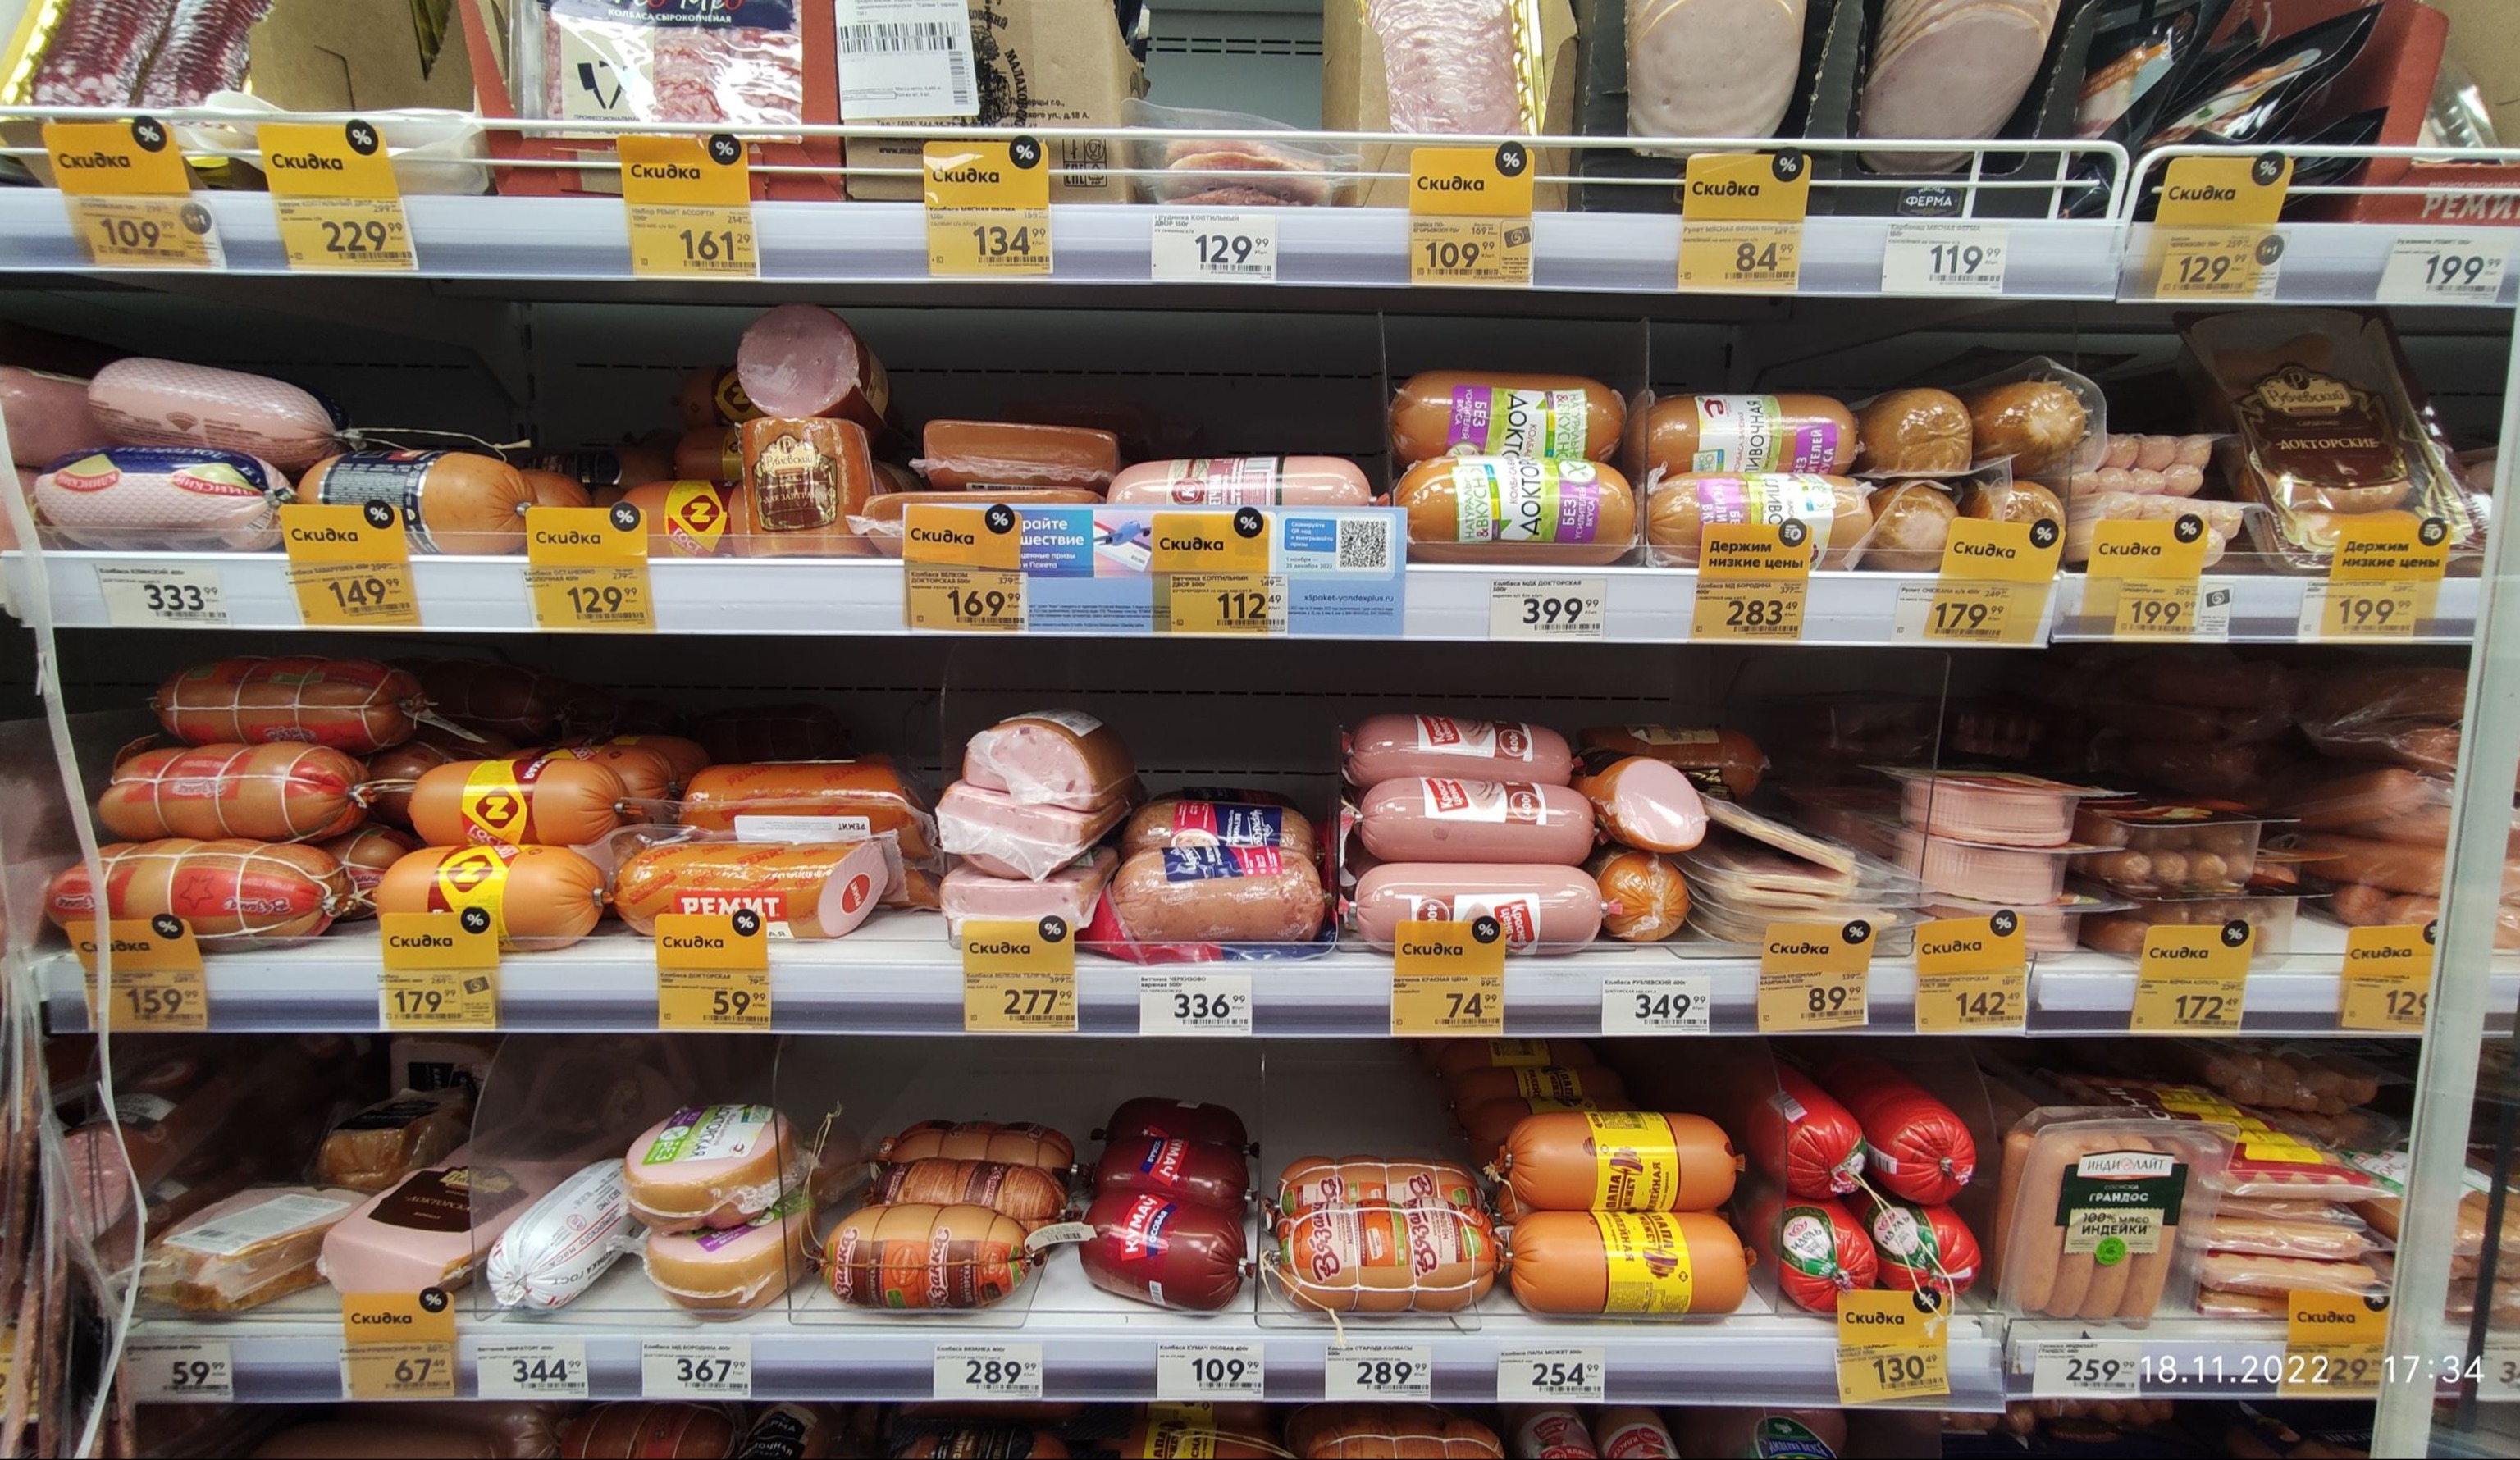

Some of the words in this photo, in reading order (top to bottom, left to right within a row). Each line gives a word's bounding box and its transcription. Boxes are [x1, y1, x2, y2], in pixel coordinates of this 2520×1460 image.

[609, 8, 655, 21] КОЛБАСА
[59, 153, 130, 168] Скидка
[272, 154, 343, 170] Скидка
[632, 164, 700, 179] Скидка
[933, 168, 999, 183] Скидка
[1418, 176, 1484, 191] Скидка
[1692, 181, 1759, 196] Скидка
[2169, 185, 2235, 200] Скидка
[1906, 194, 1952, 208] ФЕРМА
[101, 219, 159, 248] 109
[322, 221, 386, 252] 229
[388, 222, 402, 232] 99
[974, 226, 1030, 256] 134
[1032, 228, 1046, 238] 99
[680, 230, 733, 261] 161
[737, 234, 750, 243] 29
[1195, 235, 1252, 263] 129
[1255, 238, 1268, 247] 99
[1426, 242, 1479, 267] 109
[1482, 241, 1495, 250] 99
[1737, 243, 1777, 271] 84
[1781, 244, 1793, 253] 99
[1931, 245, 1983, 274] 119
[1987, 248, 2001, 257] 99
[2180, 257, 2230, 282] 129
[2235, 254, 2247, 262] 99
[2426, 255, 2484, 284] 199
[2488, 258, 2500, 267] 99
[1472, 400, 1487, 428] БЕЗ
[2280, 437, 2378, 451] ДОКТОРСКИЕ
[1562, 498, 1576, 526] БЕЗ
[292, 528, 358, 541] Скидка
[911, 528, 974, 545] Скидка
[1022, 518, 1068, 533] райте
[536, 531, 600, 544] Скидка
[1020, 536, 1084, 547] шествие
[1160, 537, 1223, 550] Скидка
[1710, 540, 1772, 555] Держим
[2099, 542, 2161, 555] Скидка
[2344, 541, 2409, 554] Держим
[1051, 552, 1075, 561] призы
[1954, 541, 2016, 558] Скидка
[1708, 556, 1761, 569] низкие
[1764, 558, 1803, 571] цены
[2341, 555, 2394, 568] низкие
[2399, 556, 2440, 571] цены
[329, 578, 386, 608] 149
[386, 578, 399, 586] 99
[1172, 581, 1190, 589] ДВОР
[144, 584, 203, 611] 333
[568, 587, 622, 613] 129
[624, 587, 637, 595] 99
[947, 590, 1005, 616] 169
[1008, 593, 1020, 601] 99
[1218, 593, 1266, 619] 112
[1523, 598, 1582, 623] 399
[1727, 600, 1783, 626] 283
[1936, 603, 1988, 632] 179
[2132, 601, 2180, 624] 199
[2340, 599, 2394, 624] 199
[1509, 731, 1521, 753] 400г
[1521, 796, 1533, 817] 400г
[838, 823, 866, 832] РЕМИТ
[681, 897, 780, 916] РЕМИТ
[80, 940, 151, 953] Сдка
[390, 935, 452, 947] Скидка
[663, 936, 724, 948] Скидка
[970, 942, 1030, 954] Скидка
[1403, 943, 1463, 956] Скидка
[1770, 943, 1829, 954] Скидка
[1922, 941, 1981, 954] Скидка
[2150, 947, 2208, 958] Скидка
[2350, 947, 2412, 959] Скидка
[126, 990, 182, 1014] 159
[395, 991, 441, 1012] 179
[712, 990, 750, 1015] 59
[1004, 990, 1057, 1014] 277
[1060, 991, 1072, 999] 99
[1175, 994, 1230, 1018] 336
[1447, 993, 1482, 1018] 74
[1636, 994, 1690, 1018] 349
[1809, 987, 1846, 1011] 89
[1956, 992, 2005, 1016] 142
[2176, 996, 2223, 1020] 172
[1606, 1174, 1621, 1209] ПАПА
[2089, 1191, 2149, 1203] ГРАНДОС
[1124, 1196, 1157, 1254] КУМАЧ
[1148, 1209, 1168, 1245] ОСОБАЯ
[2082, 1211, 2116, 1225] 100%
[352, 1312, 412, 1324] Скидка
[1846, 1312, 1904, 1325] Скидка
[2298, 1311, 2355, 1323] Скидка
[172, 1361, 208, 1385] 59
[395, 1358, 431, 1382] 67
[513, 1360, 567, 1382] 344
[678, 1358, 731, 1382] 367
[966, 1360, 1021, 1384] 289
[1191, 1358, 1245, 1382] 109
[1357, 1362, 1412, 1385] 289
[1532, 1363, 1584, 1386] 254
[1872, 1355, 1924, 1383] 130
[2066, 1359, 2120, 1381] 259
